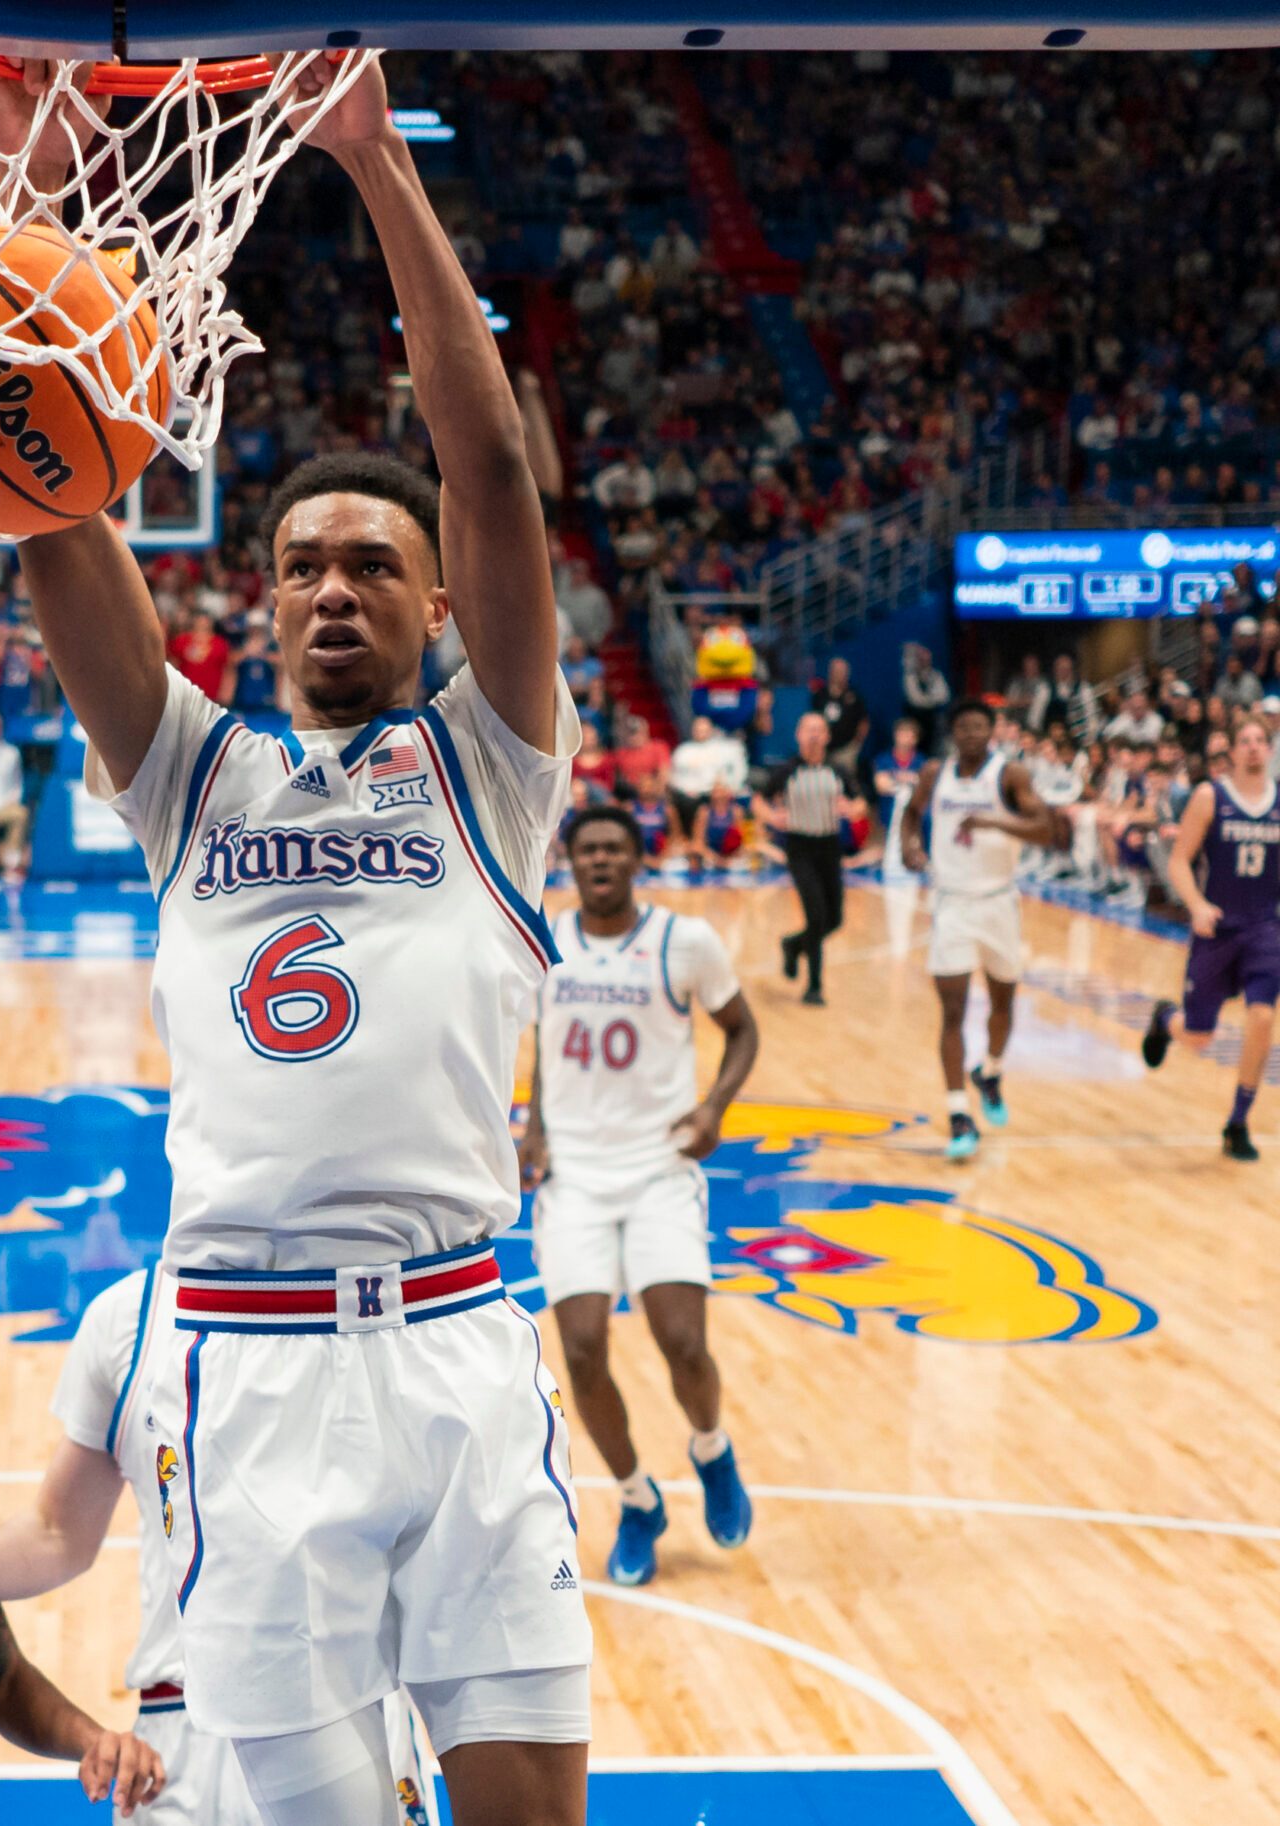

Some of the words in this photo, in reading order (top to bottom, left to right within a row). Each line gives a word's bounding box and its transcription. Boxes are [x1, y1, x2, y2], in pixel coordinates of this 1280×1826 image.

[291, 780, 332, 799] adidas
[192, 813, 445, 901] Kansas
[1236, 843, 1266, 877] 13
[230, 913, 361, 1063] 6
[561, 1018, 640, 1071] 40
